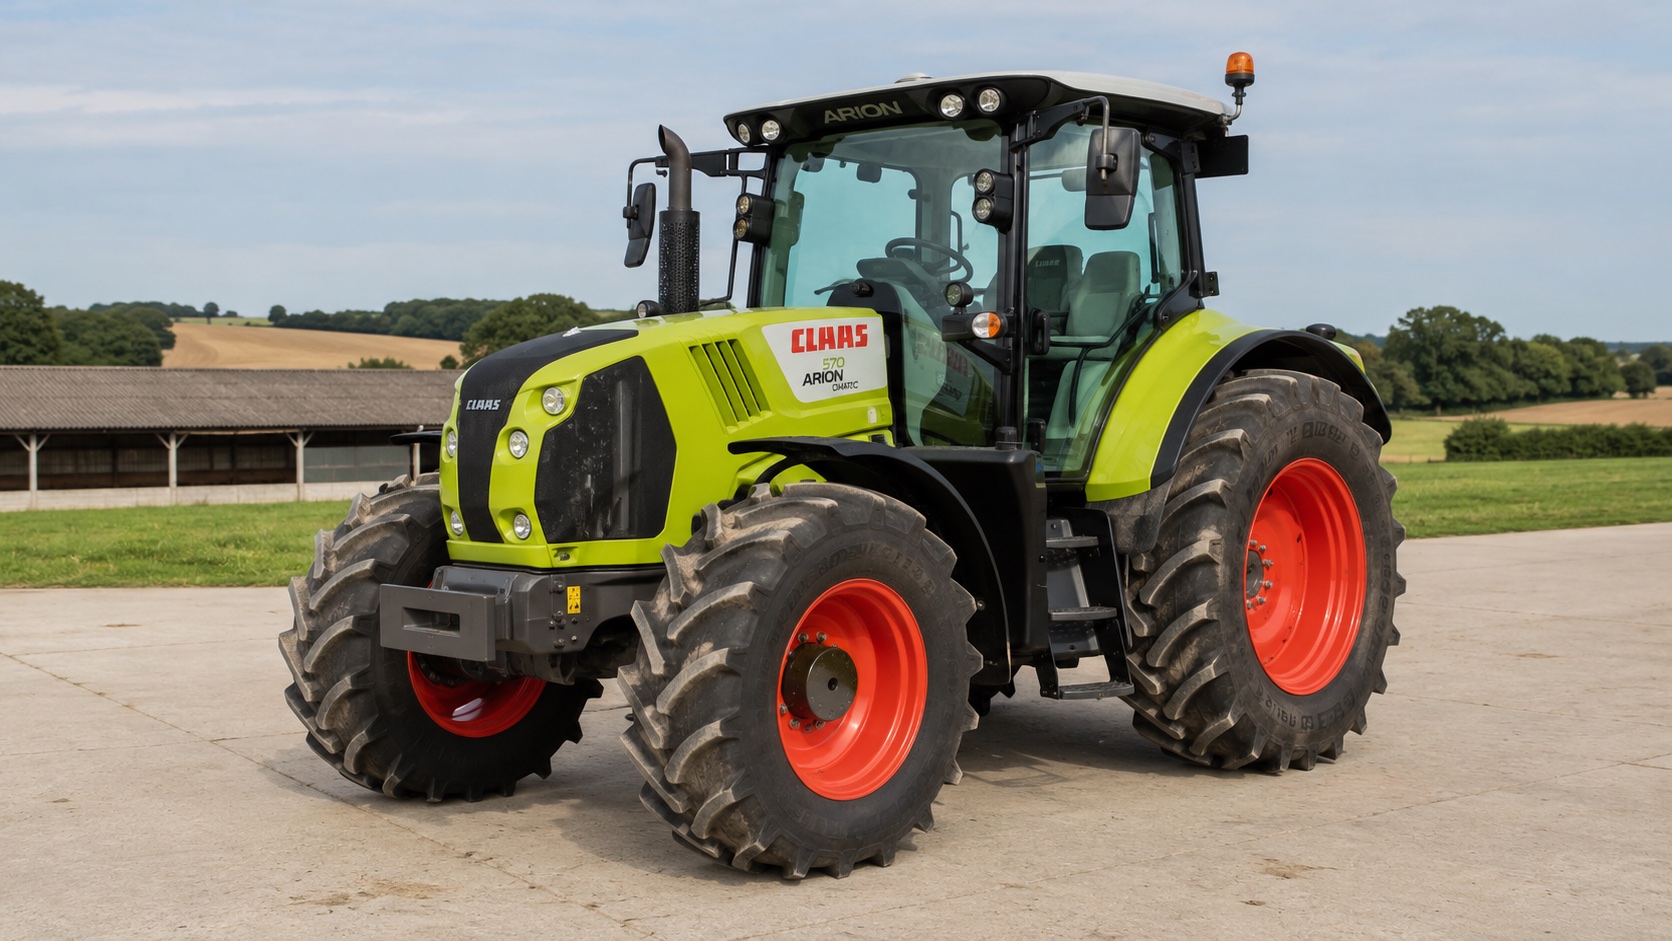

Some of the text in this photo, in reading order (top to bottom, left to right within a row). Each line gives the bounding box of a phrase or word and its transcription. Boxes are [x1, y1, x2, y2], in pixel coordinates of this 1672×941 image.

[824, 101, 903, 124] ARION
[791, 324, 868, 353] CLAAS
[823, 357, 845, 370] 570
[802, 369, 844, 386] ARION
[466, 400, 501, 410] CLAAS
